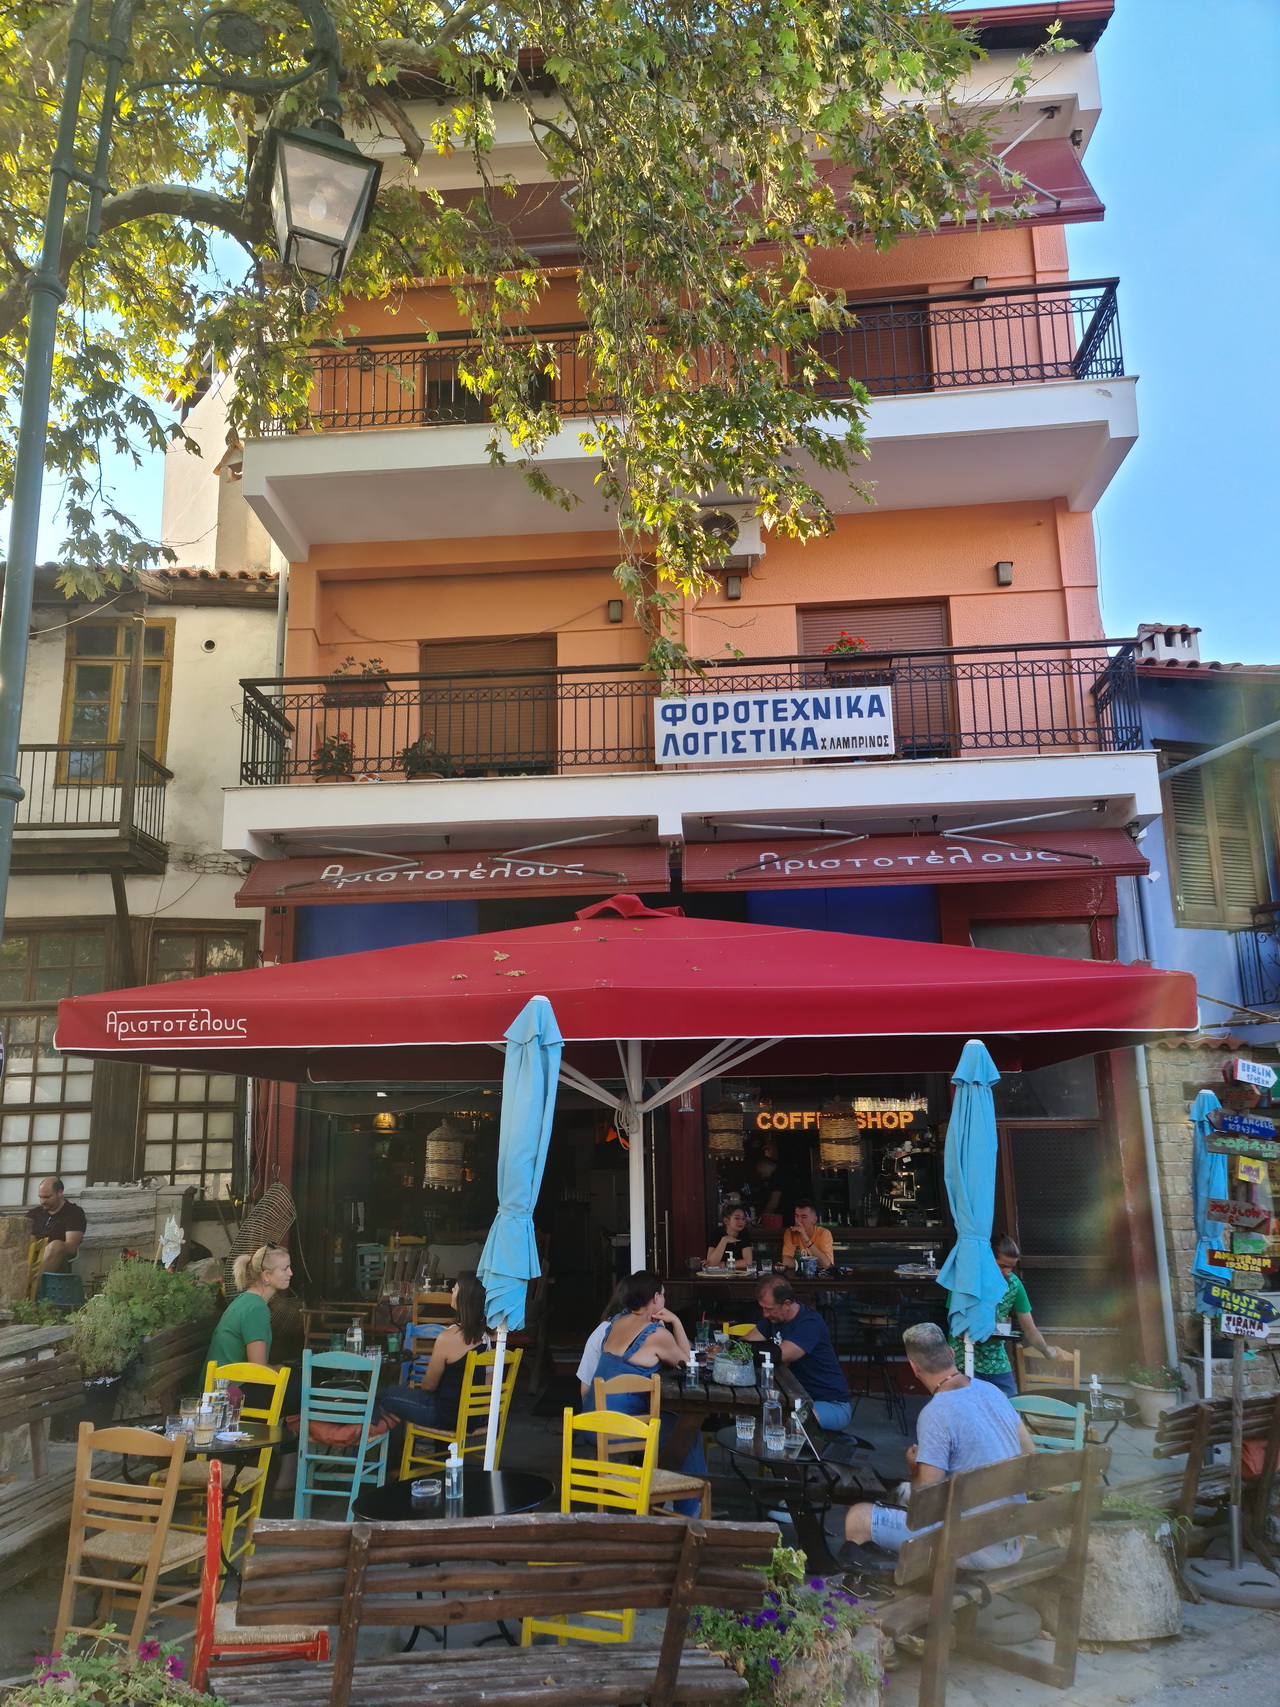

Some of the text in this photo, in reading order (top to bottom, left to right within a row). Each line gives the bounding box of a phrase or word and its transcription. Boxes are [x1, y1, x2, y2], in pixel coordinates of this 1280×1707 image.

[661, 694, 886, 726] ΦΟΡΟΤΕΧΝΙΚΑ
[662, 727, 819, 757] ΛΟΓΙΣΤΙΚΑ
[106, 1009, 247, 1041] Αριστοτέλους
[1241, 1063, 1272, 1078] BERLIN
[756, 1111, 914, 1130] COFF SHOP
[1226, 1315, 1264, 1331] TIRANA
